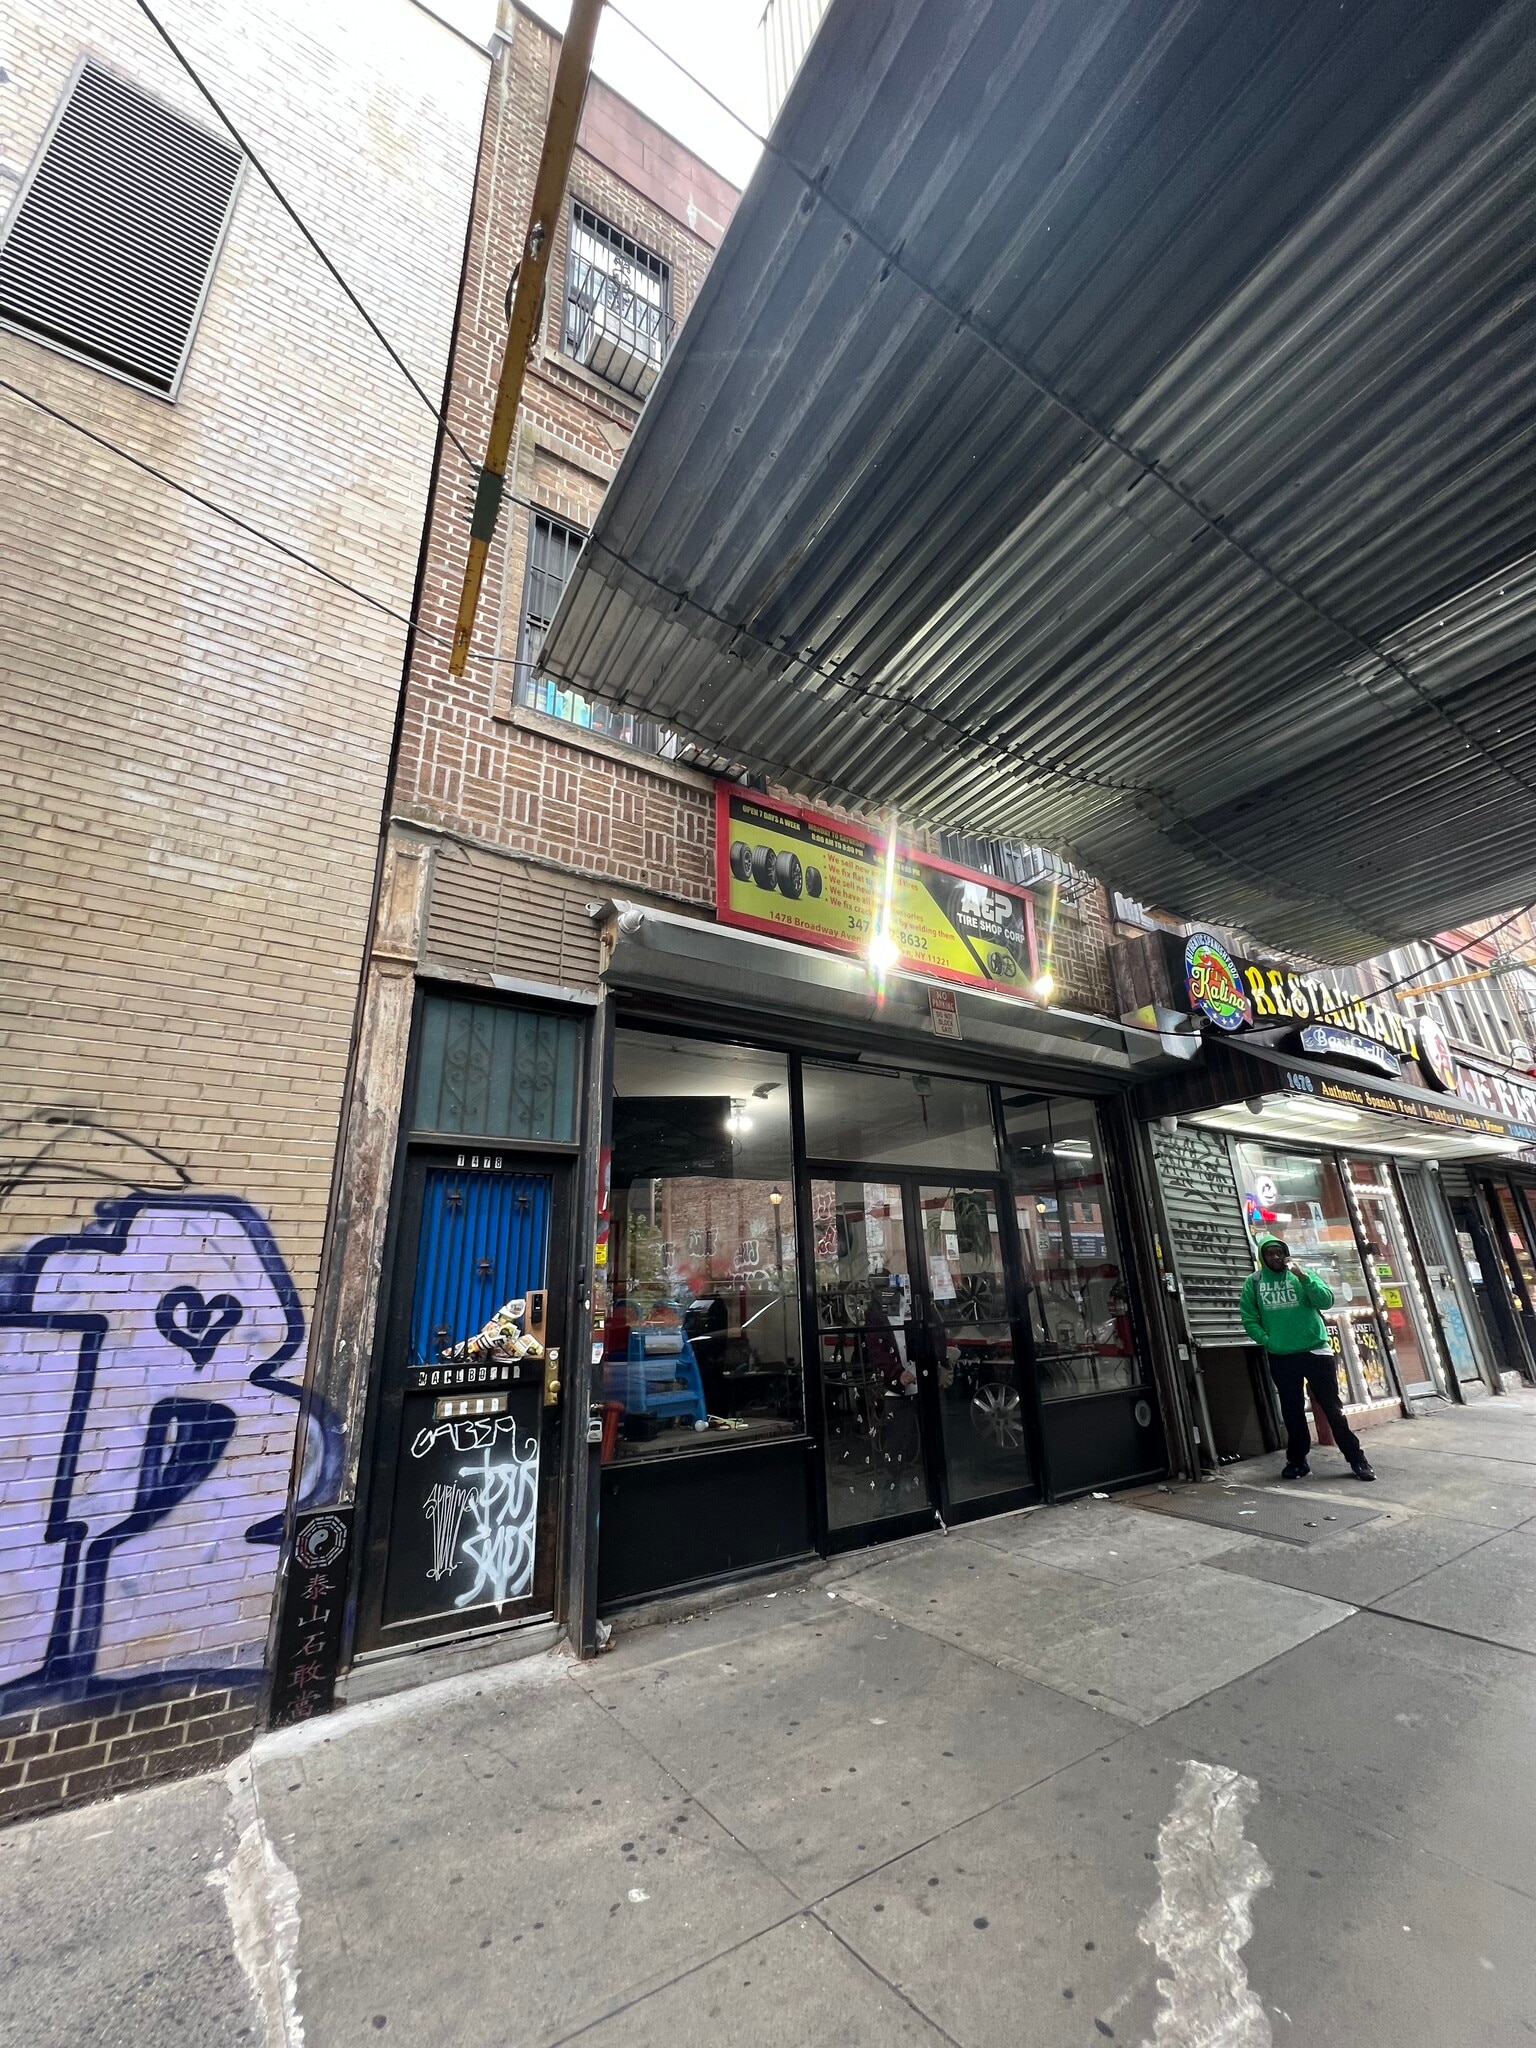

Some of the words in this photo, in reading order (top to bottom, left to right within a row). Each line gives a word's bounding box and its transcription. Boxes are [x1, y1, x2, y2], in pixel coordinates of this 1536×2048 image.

[742, 804, 760, 816] OPEN
[763, 812, 779, 824] DAYS
[785, 818, 801, 831] WEEK
[825, 837, 834, 847] AM
[834, 840, 842, 849] TO
[855, 847, 864, 857] PM
[827, 854, 840, 864] We
[841, 857, 854, 869] sell
[855, 864, 870, 873] new
[828, 864, 840, 874] We
[841, 868, 852, 878] fix
[852, 871, 865, 883] flat
[829, 875, 841, 885] We
[842, 878, 855, 890] sell
[829, 886, 842, 896] We
[842, 890, 861, 902] have
[830, 897, 842, 907] We
[843, 900, 853, 910] fix
[769, 911, 793, 924] 1478
[794, 917, 840, 939] Broadway
[898, 919, 908, 929] by
[909, 921, 937, 938] welding
[938, 930, 956, 941] them
[957, 913, 979, 929] TIRE
[980, 920, 1003, 936] SHOP
[1004, 929, 1026, 944] CORP
[914, 951, 926, 961] NY
[928, 954, 950, 967] 11221
[936, 991, 948, 1001] NO
[1191, 966, 1246, 1012] Kalina
[932, 999, 955, 1011] PARKING
[1244, 966, 1420, 1060] RESTAURANT
[1321, 1081, 1364, 1103] Authentic
[1365, 1091, 1396, 1110] Spanish
[1397, 1100, 1418, 1116] Food
[1424, 1106, 1456, 1124] Breakfast
[1460, 1114, 1481, 1130] Lunch
[1484, 1119, 1505, 1134] Dinner
[457, 1155, 502, 1168] 1478
[1260, 1280, 1295, 1292] BLACK
[1260, 1289, 1298, 1305] KING
[287, 1573, 336, 1720] 泰山石敢當
